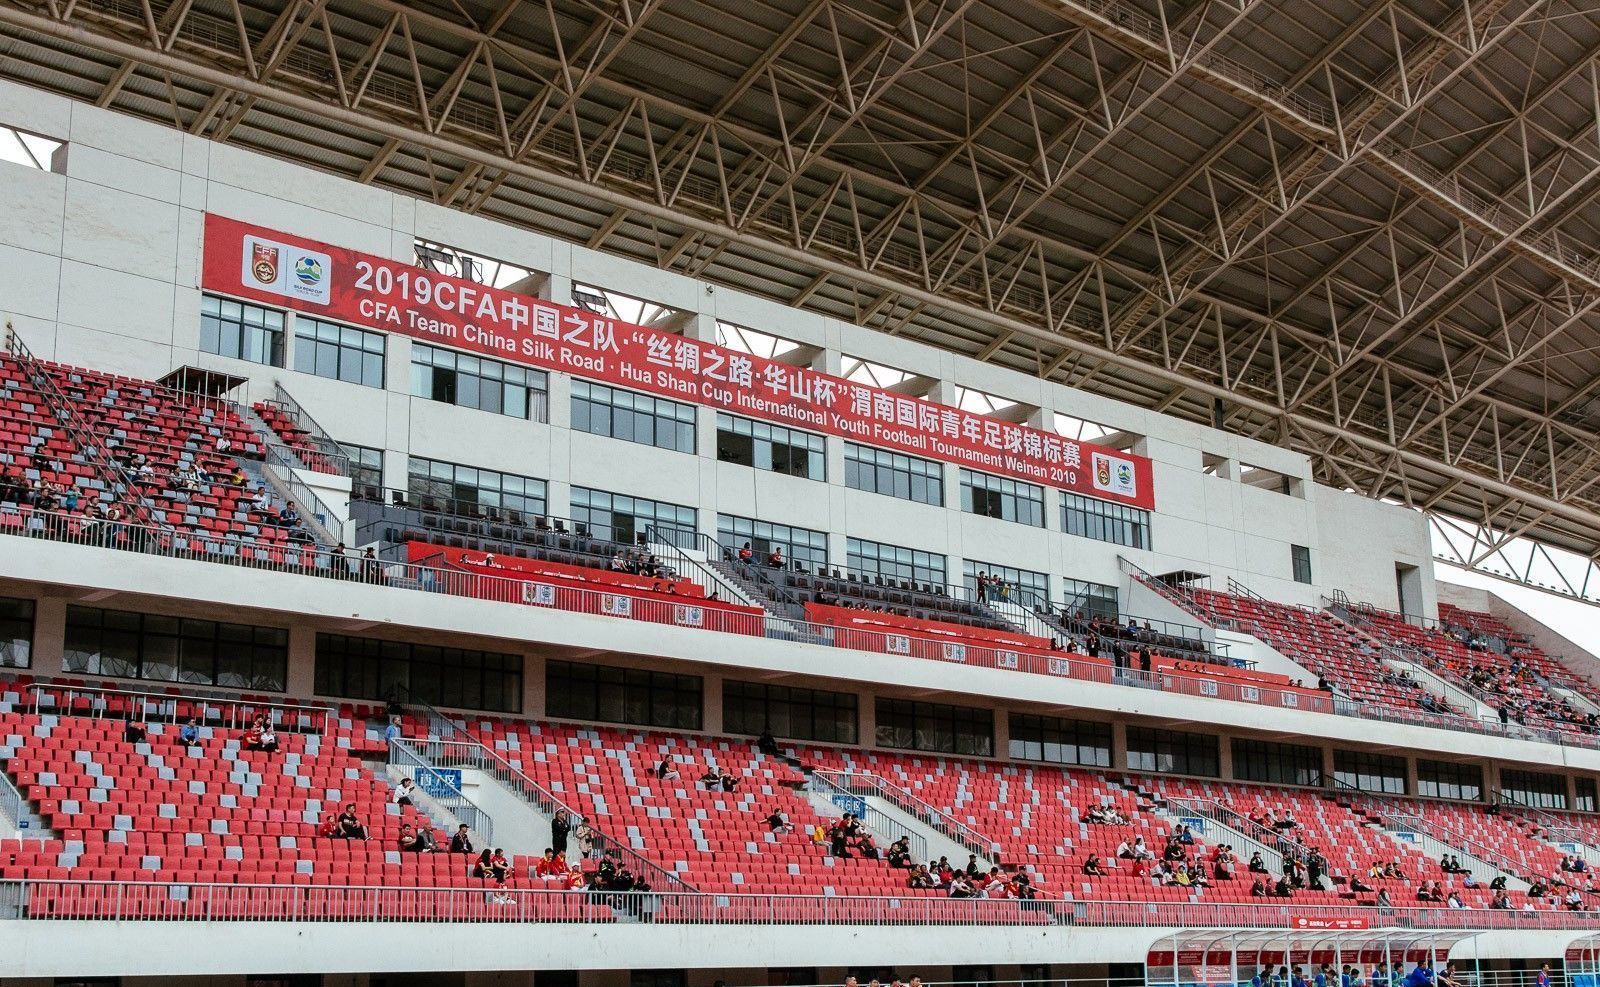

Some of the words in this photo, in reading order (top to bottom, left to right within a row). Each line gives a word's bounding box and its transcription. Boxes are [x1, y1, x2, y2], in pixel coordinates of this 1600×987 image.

[359, 299, 401, 325] CFA
[407, 310, 456, 338] Team
[463, 324, 517, 352] China
[522, 338, 555, 361] Silk
[560, 347, 604, 372] Road
[620, 362, 652, 384] Hua
[657, 371, 697, 395] Shan
[702, 382, 733, 406] Cup
[737, 390, 828, 427] International
[831, 413, 870, 436] Youth
[874, 423, 927, 450] Football
[930, 437, 1003, 468] Tournament
[1005, 455, 1048, 480] Weinan
[1050, 467, 1077, 485] 2019
